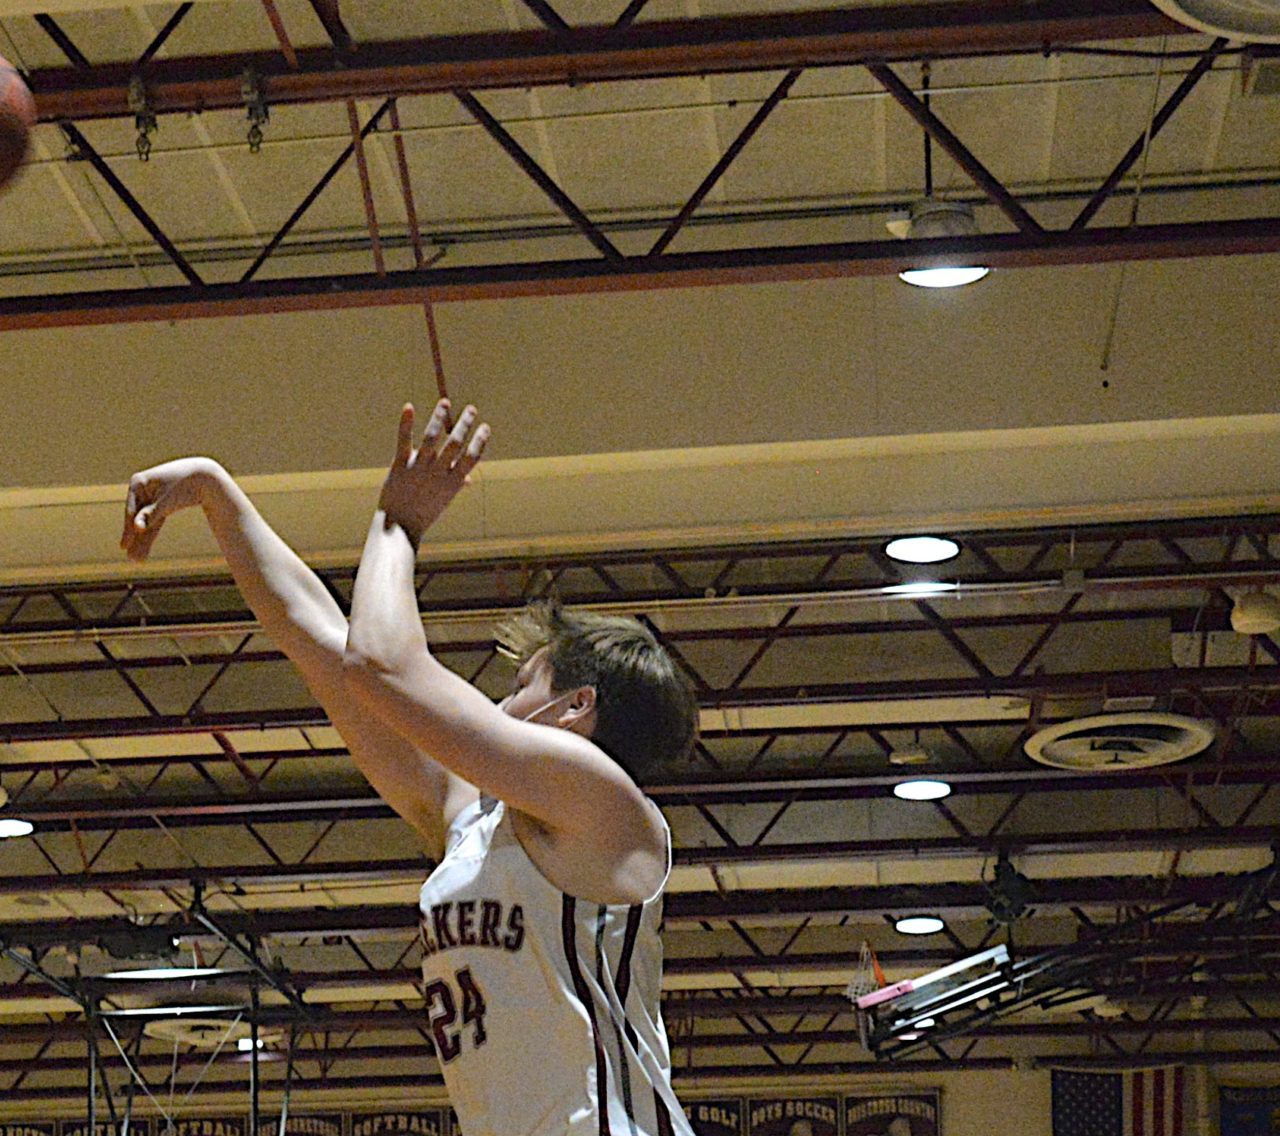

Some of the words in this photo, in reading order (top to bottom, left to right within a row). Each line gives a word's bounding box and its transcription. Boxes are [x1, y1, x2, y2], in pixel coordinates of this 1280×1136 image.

[425, 966, 487, 1064] 24
[697, 1104, 739, 1130] GOLF
[785, 1100, 836, 1125] SOCCER
